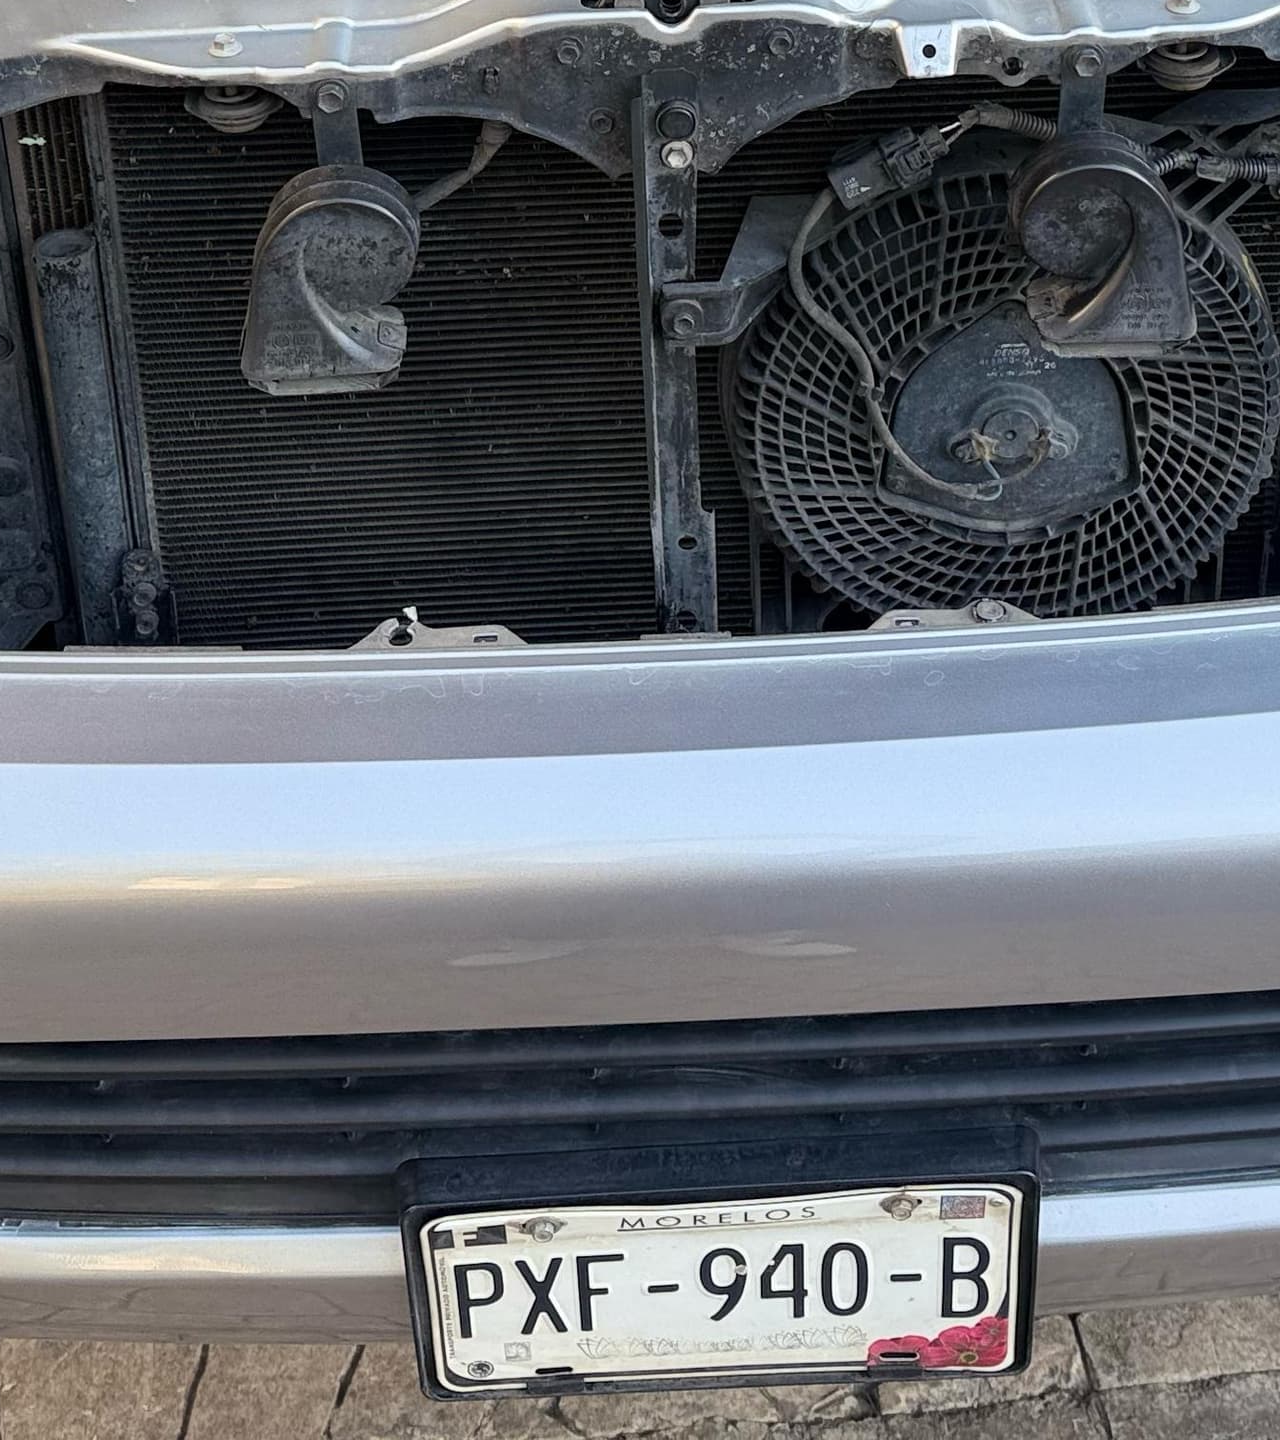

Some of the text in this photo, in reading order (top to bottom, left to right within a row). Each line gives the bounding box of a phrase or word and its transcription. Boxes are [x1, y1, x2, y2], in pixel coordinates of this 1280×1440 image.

[619, 1205, 817, 1231] MORELOS
[453, 1236, 991, 1339] PXF-940-B
[442, 1294, 452, 1321] PRIVADO
[445, 1322, 455, 1360] TRANSPORTE
